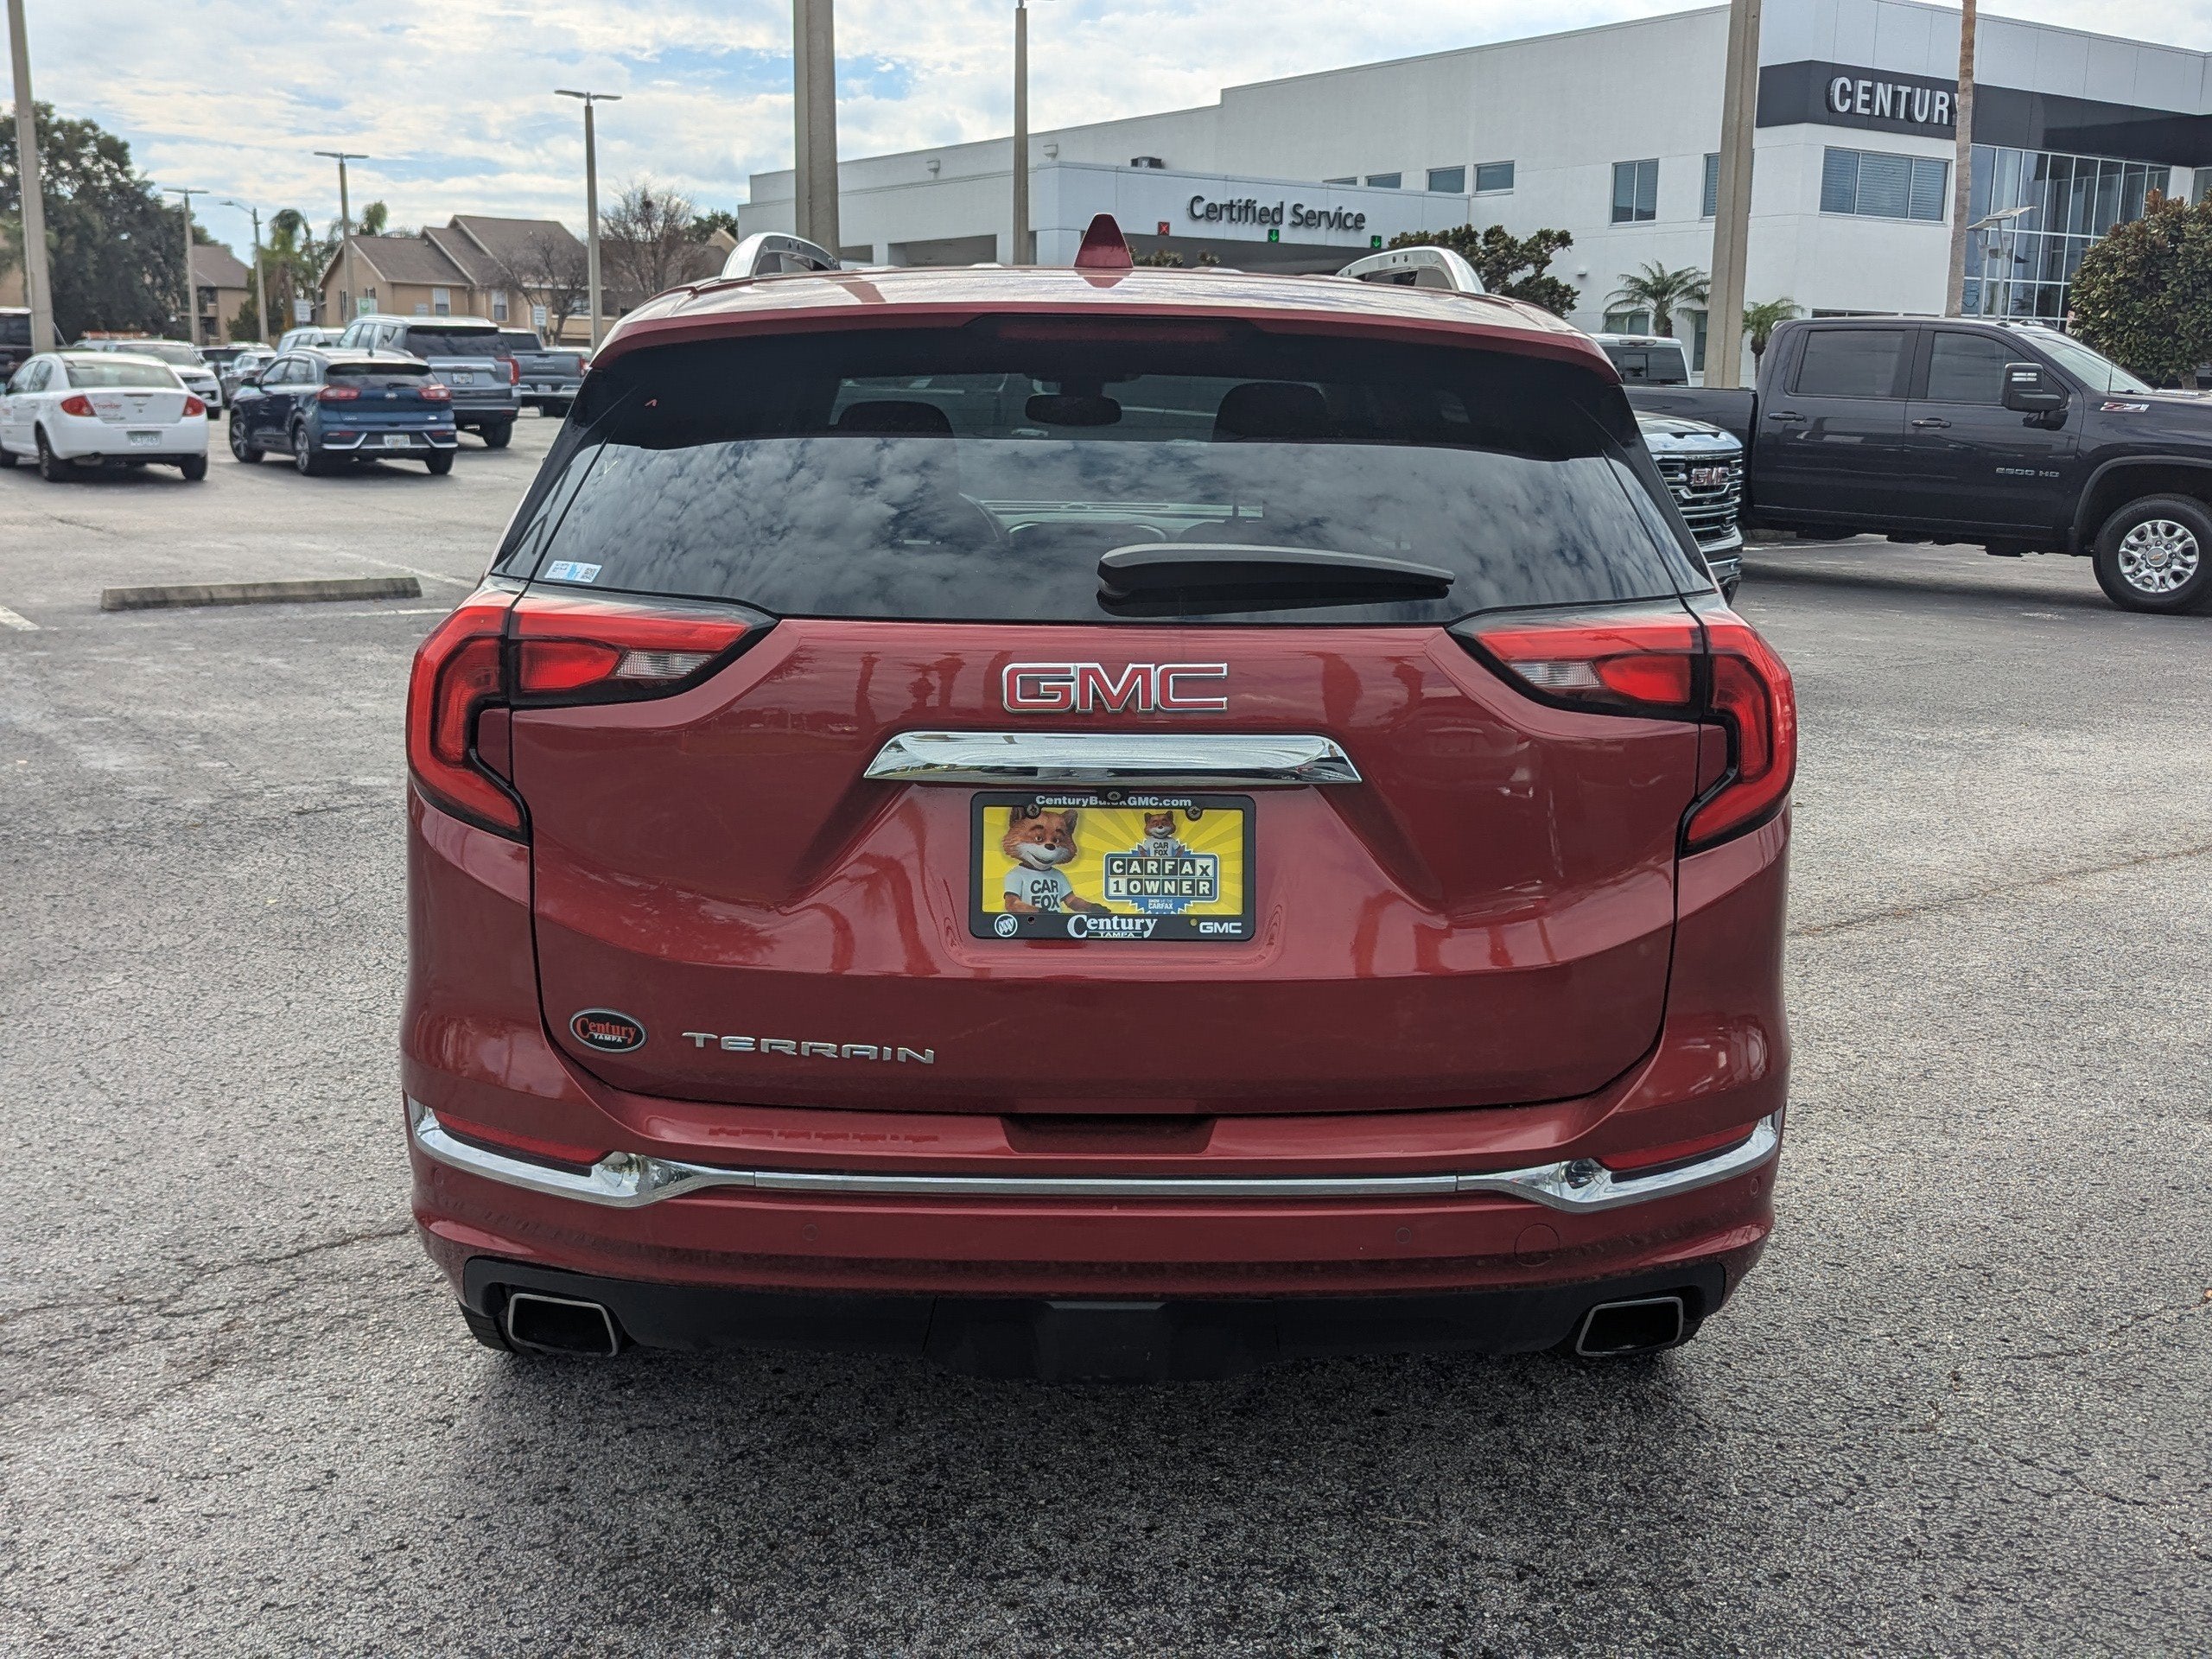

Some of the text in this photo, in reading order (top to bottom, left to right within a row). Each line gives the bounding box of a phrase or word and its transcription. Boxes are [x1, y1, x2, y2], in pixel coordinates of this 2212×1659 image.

[1188, 195, 1366, 231] Certified Service
[1001, 662, 1228, 714] GMC
[1112, 860, 1211, 876] CARFAX
[1030, 879, 1058, 894] CAR
[1032, 894, 1060, 910] FOX
[1067, 914, 1158, 938] Century
[1199, 922, 1242, 934] GMC
[576, 1017, 638, 1045] Century
[594, 1033, 622, 1044] TAMPA
[682, 1032, 934, 1065] TERRAIN
